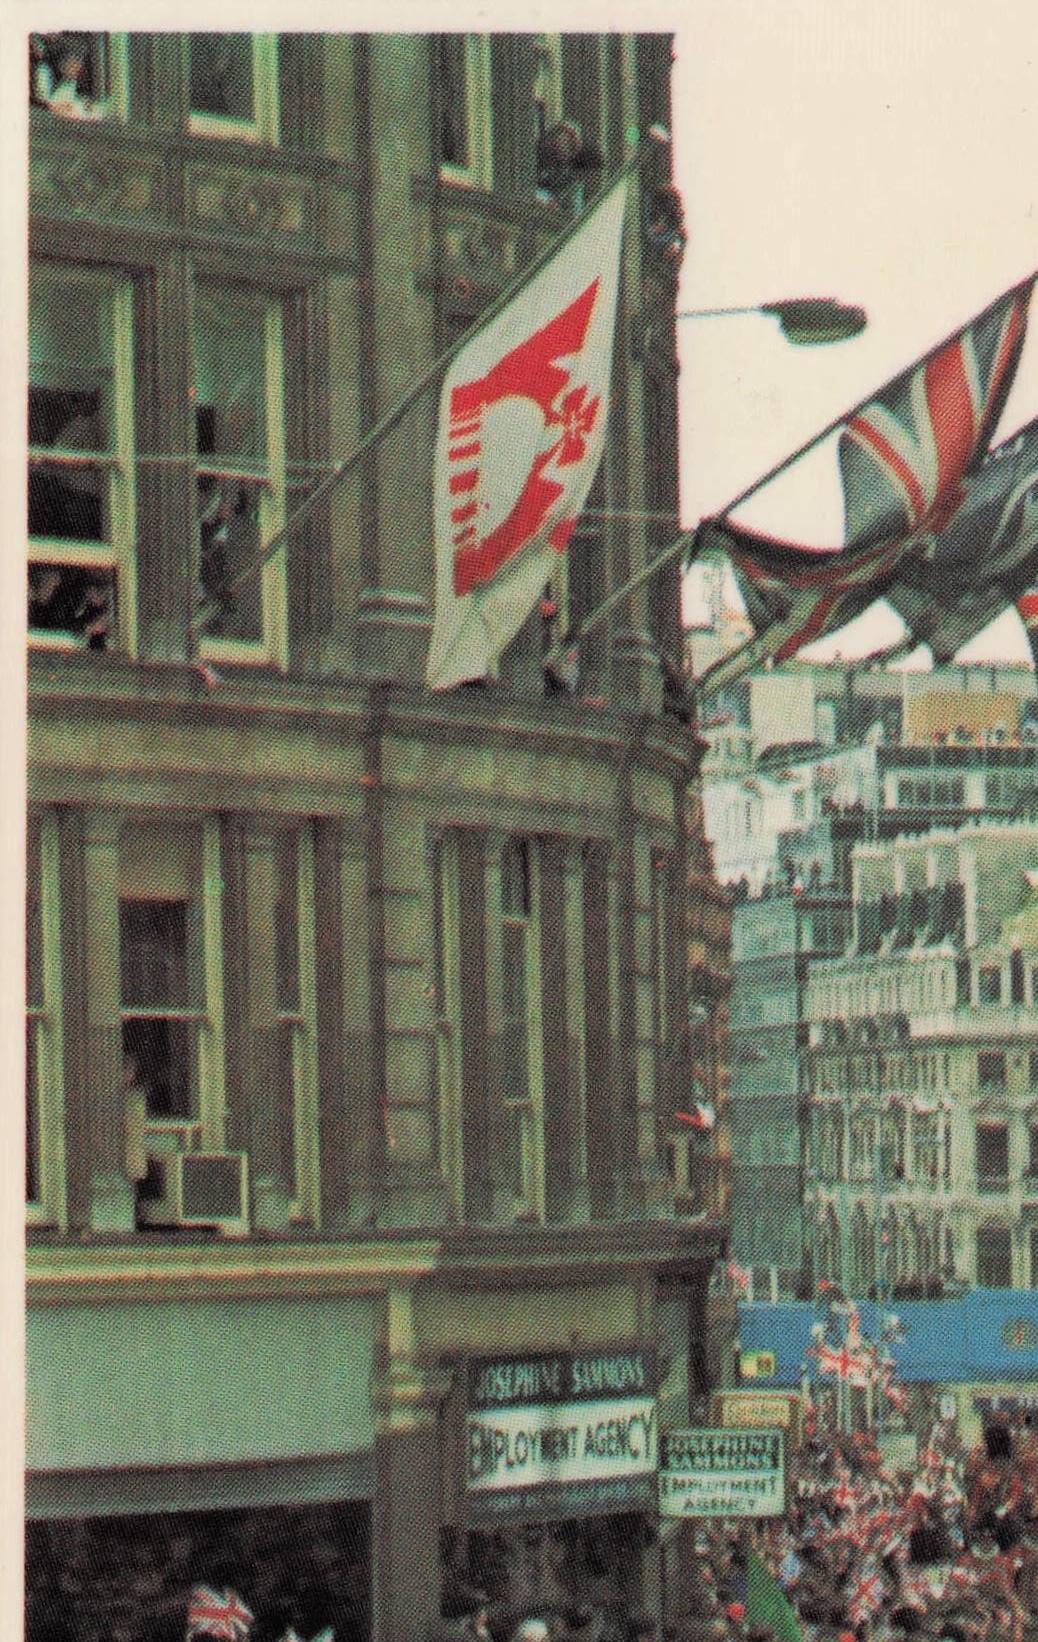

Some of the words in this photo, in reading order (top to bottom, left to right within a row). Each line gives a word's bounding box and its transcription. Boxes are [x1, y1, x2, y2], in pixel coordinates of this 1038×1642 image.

[468, 1423, 578, 1479] EMPLOYMENT
[583, 1410, 656, 1461] AGENCY
[660, 1476, 776, 1494] EMPLOYMENT
[683, 1498, 757, 1512] AGENCY
